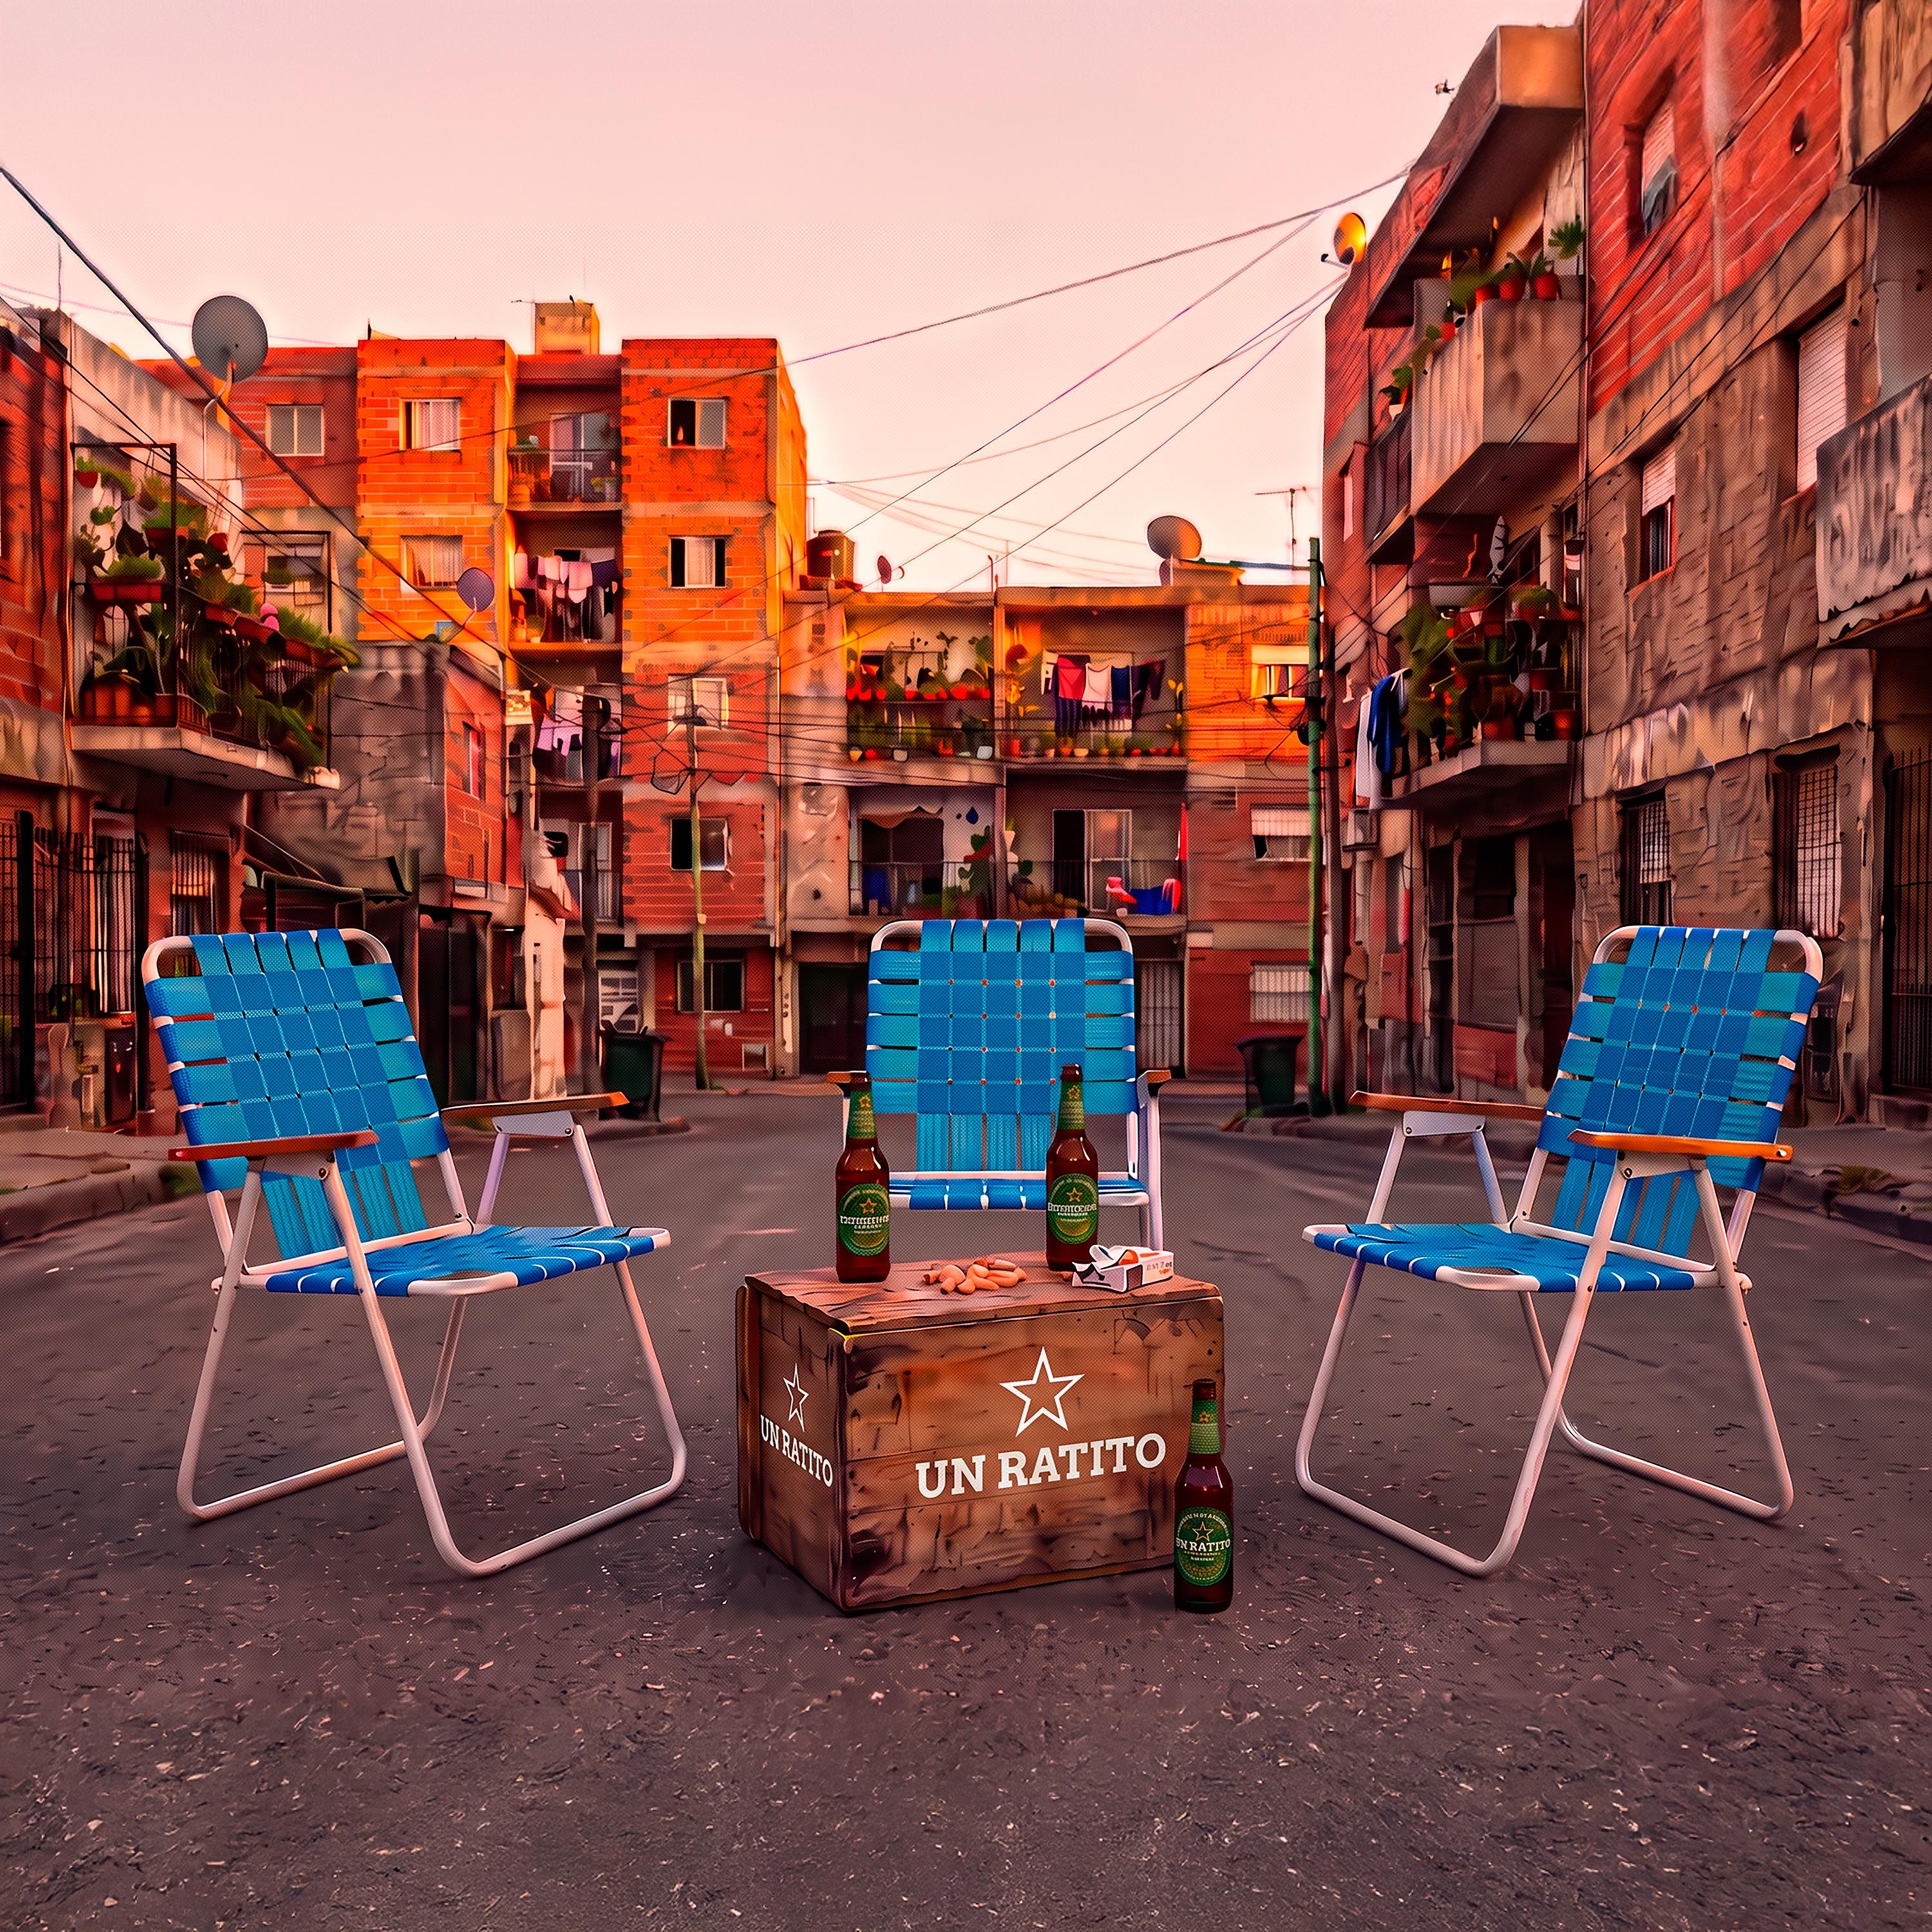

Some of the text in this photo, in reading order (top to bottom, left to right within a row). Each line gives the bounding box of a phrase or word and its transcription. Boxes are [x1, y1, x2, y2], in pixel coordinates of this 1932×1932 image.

[761, 1414, 833, 1487] UN RATITO
[915, 1432, 1166, 1499] UN RATITO
[1189, 1538, 1231, 1553] RATITO
